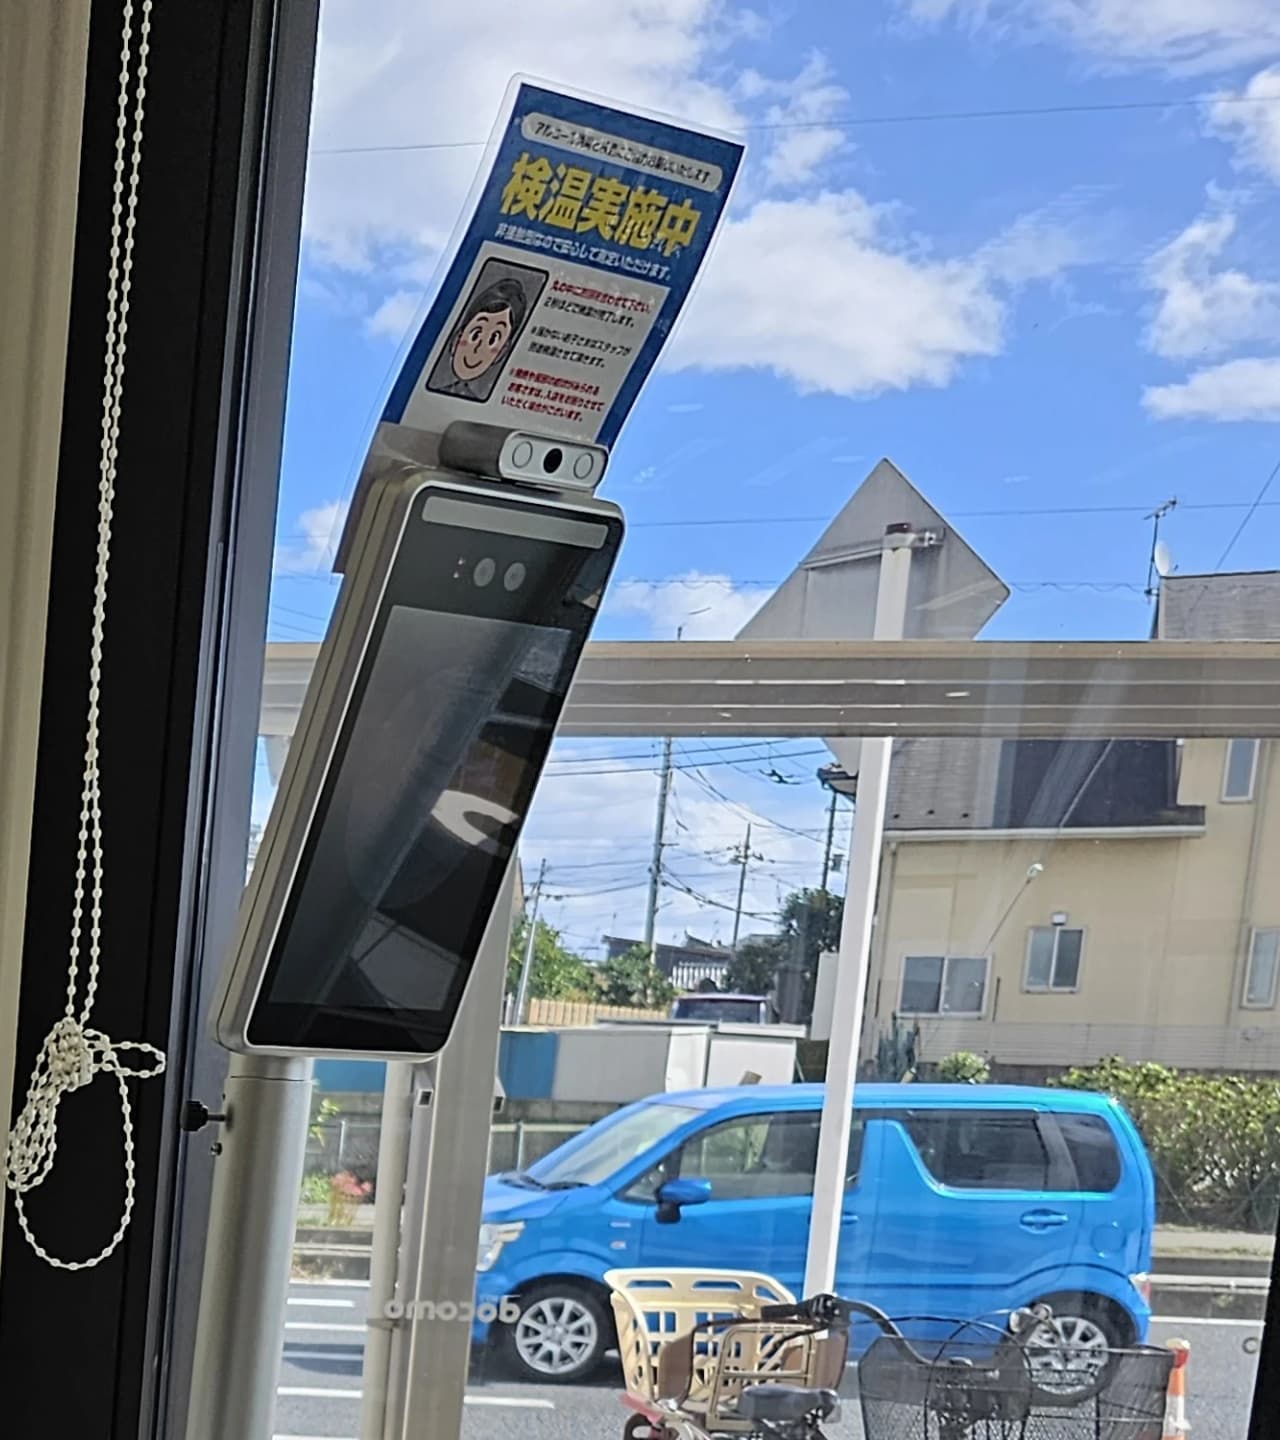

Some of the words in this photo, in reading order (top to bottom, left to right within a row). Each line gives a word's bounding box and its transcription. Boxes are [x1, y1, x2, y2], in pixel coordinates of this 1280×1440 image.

[500, 152, 703, 257] 検温実施中
